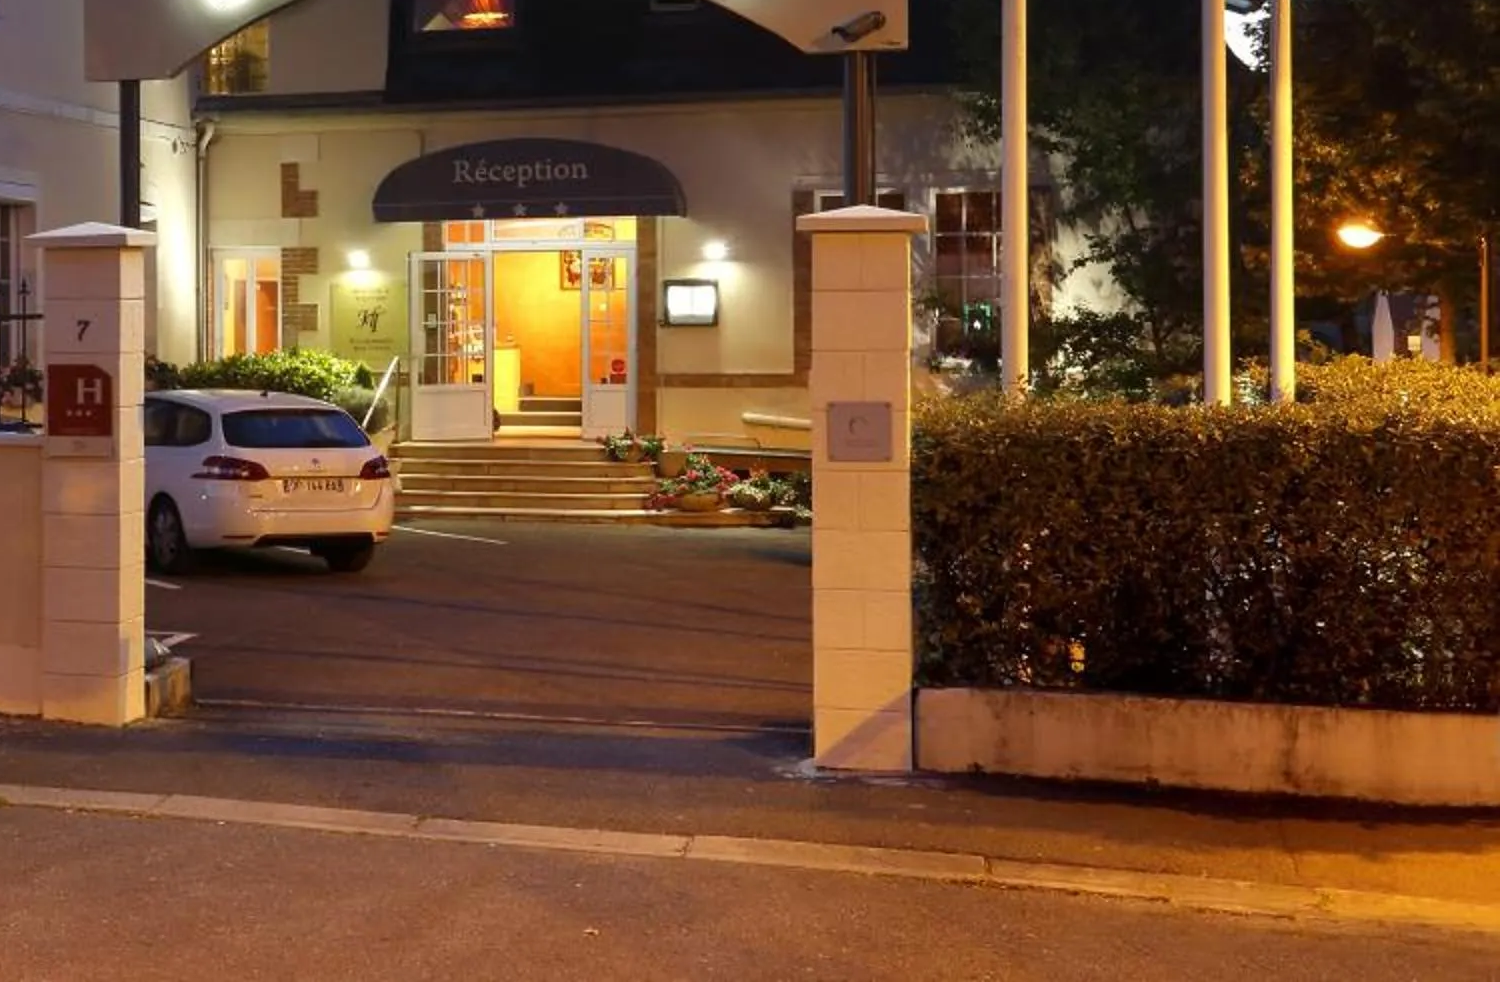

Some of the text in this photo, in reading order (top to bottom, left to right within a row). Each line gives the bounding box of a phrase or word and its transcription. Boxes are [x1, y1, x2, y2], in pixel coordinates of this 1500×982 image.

[452, 157, 589, 188] Réception
[76, 319, 92, 343] 7
[76, 377, 104, 406] H
